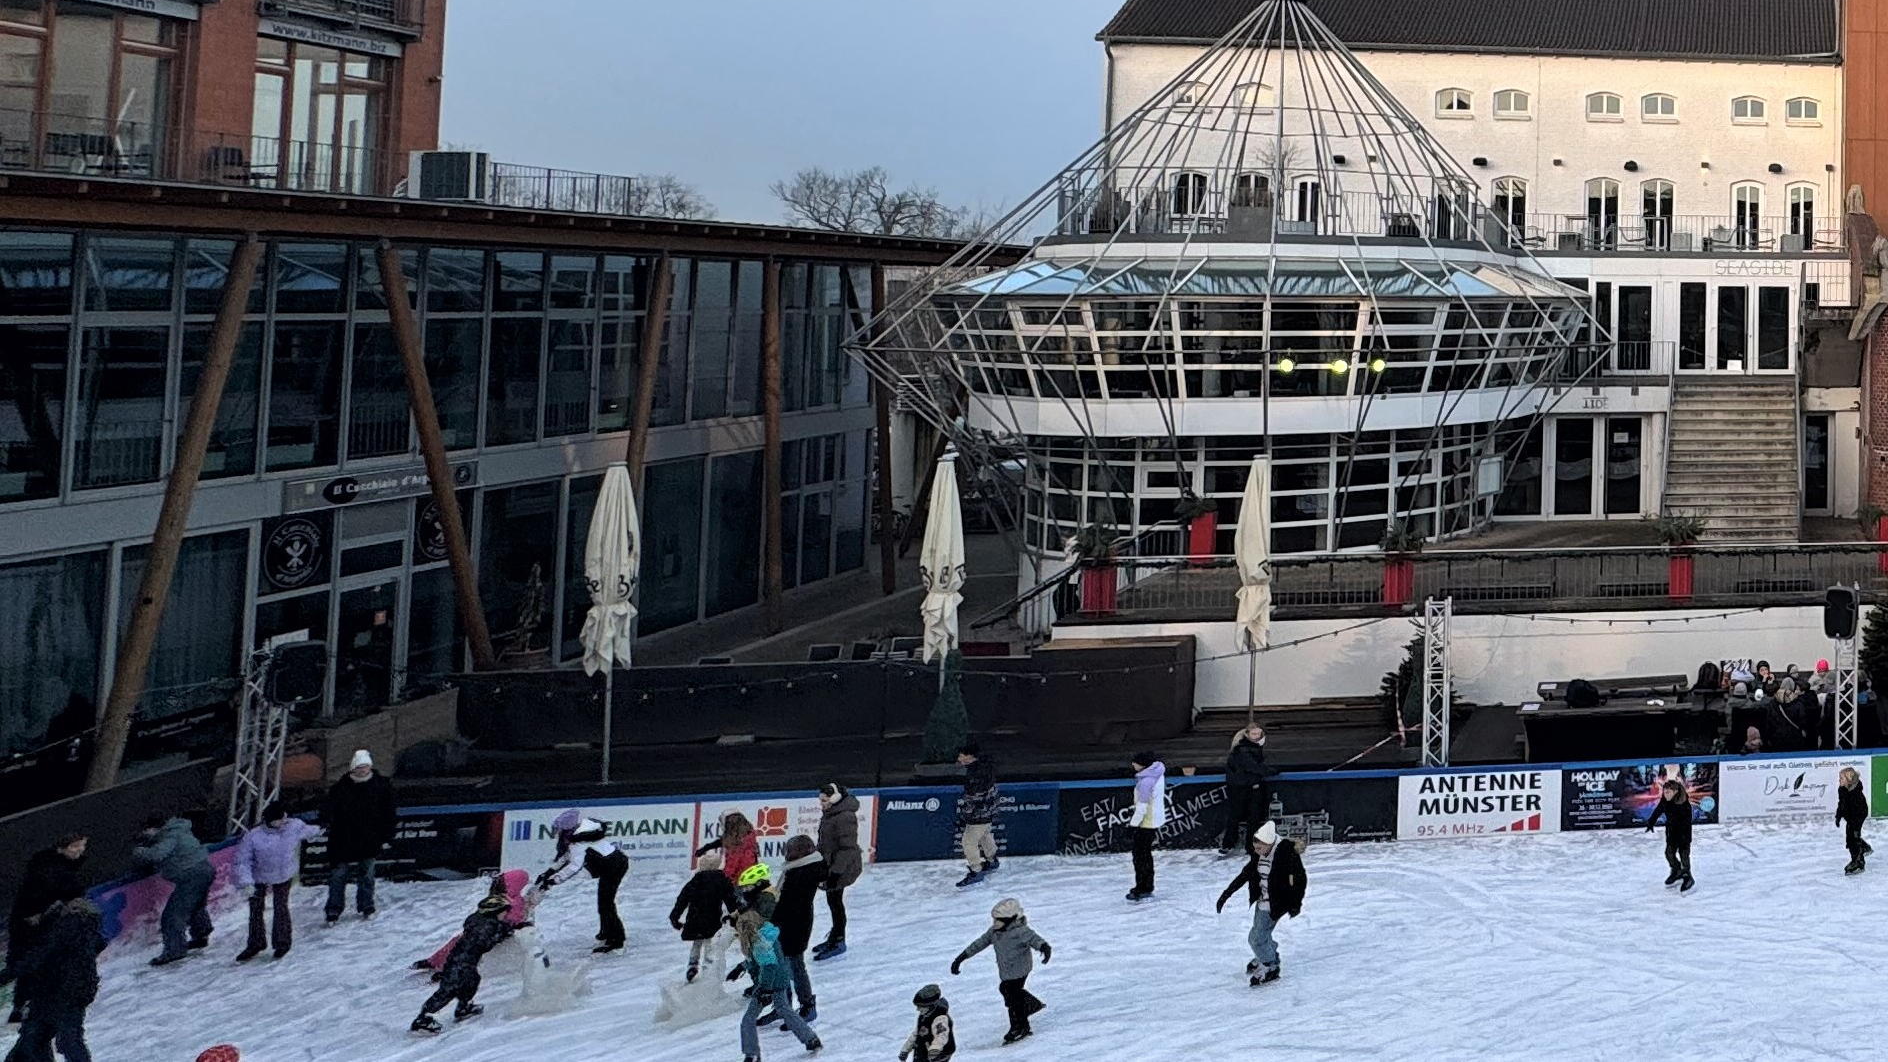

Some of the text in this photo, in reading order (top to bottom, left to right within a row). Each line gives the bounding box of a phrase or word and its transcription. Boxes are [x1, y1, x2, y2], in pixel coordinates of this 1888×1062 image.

[1715, 259, 1793, 275] SEASIDE
[1571, 770, 1621, 783] HOLIDAY
[1418, 773, 1542, 795] ANTENNE
[1586, 781, 1606, 792] ICE
[886, 800, 925, 812] Allianz
[1418, 793, 1541, 816] MÜNSTER
[1417, 823, 1485, 837] 95.4 MHz
